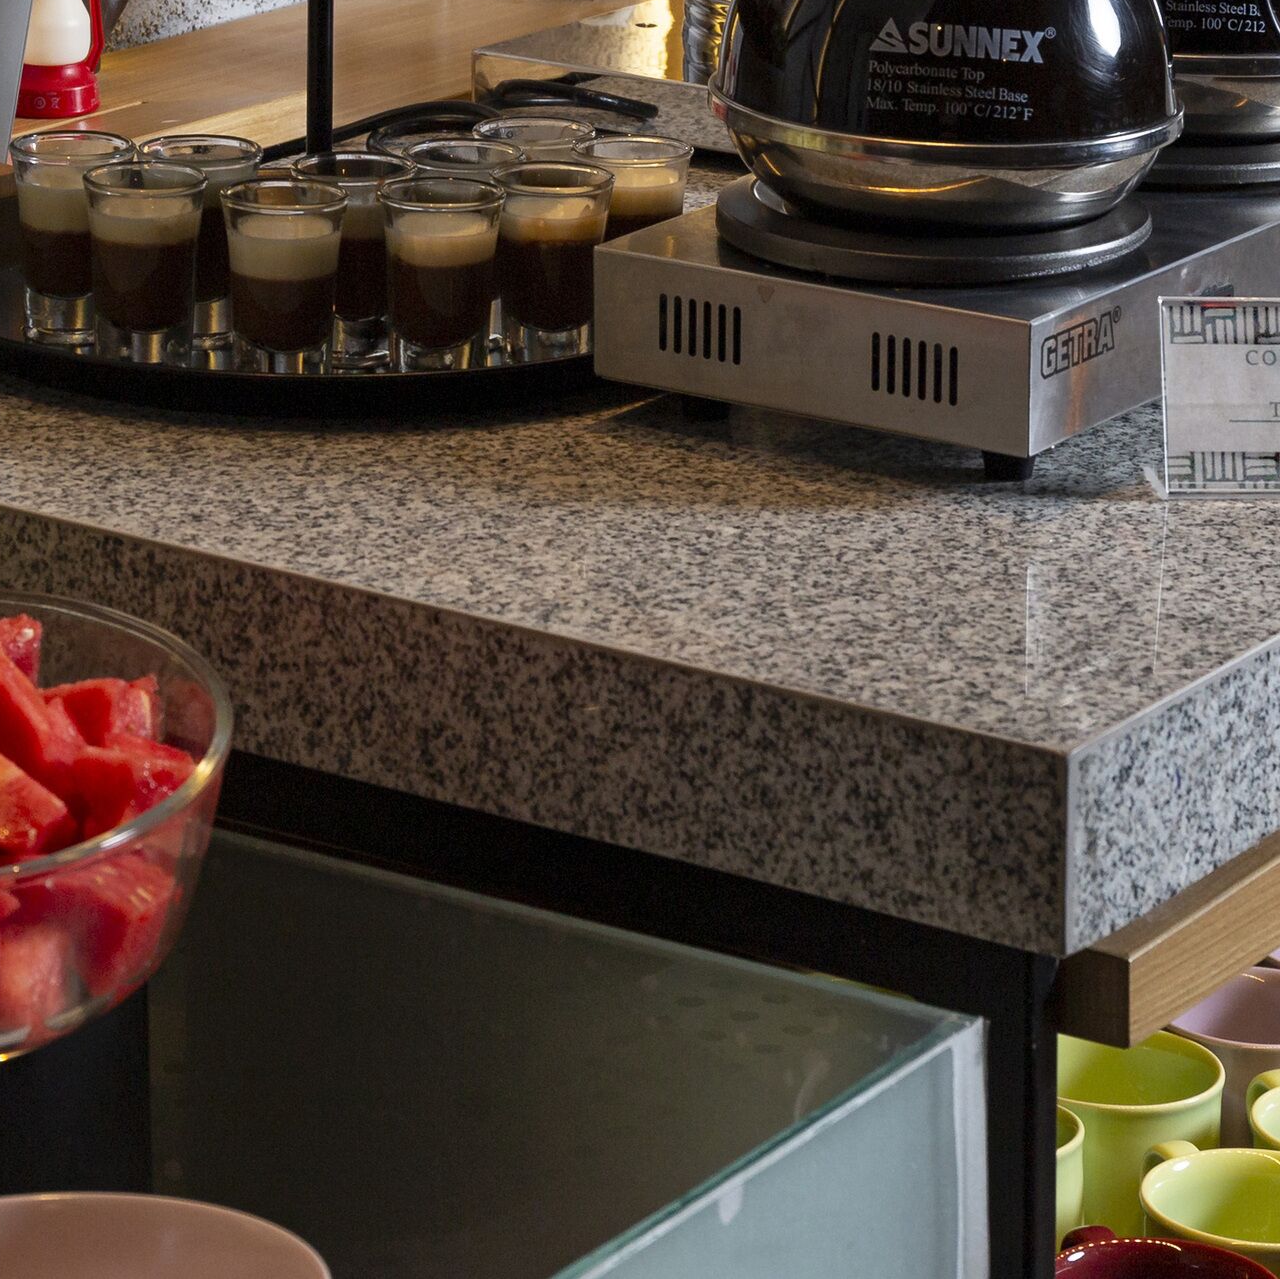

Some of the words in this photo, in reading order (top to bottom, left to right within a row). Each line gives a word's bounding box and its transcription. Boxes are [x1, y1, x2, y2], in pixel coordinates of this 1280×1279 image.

[1165, 0, 1217, 14] Stainless
[1218, 3, 1247, 16] Steel
[869, 60, 958, 79] Polycarbonate
[961, 67, 985, 83] Top
[866, 78, 902, 93] 18/10
[907, 81, 962, 97] Stainless
[965, 86, 996, 100] Steel
[999, 88, 1029, 103] Base
[866, 96, 898, 111] Max.
[902, 98, 939, 115] Temp.
